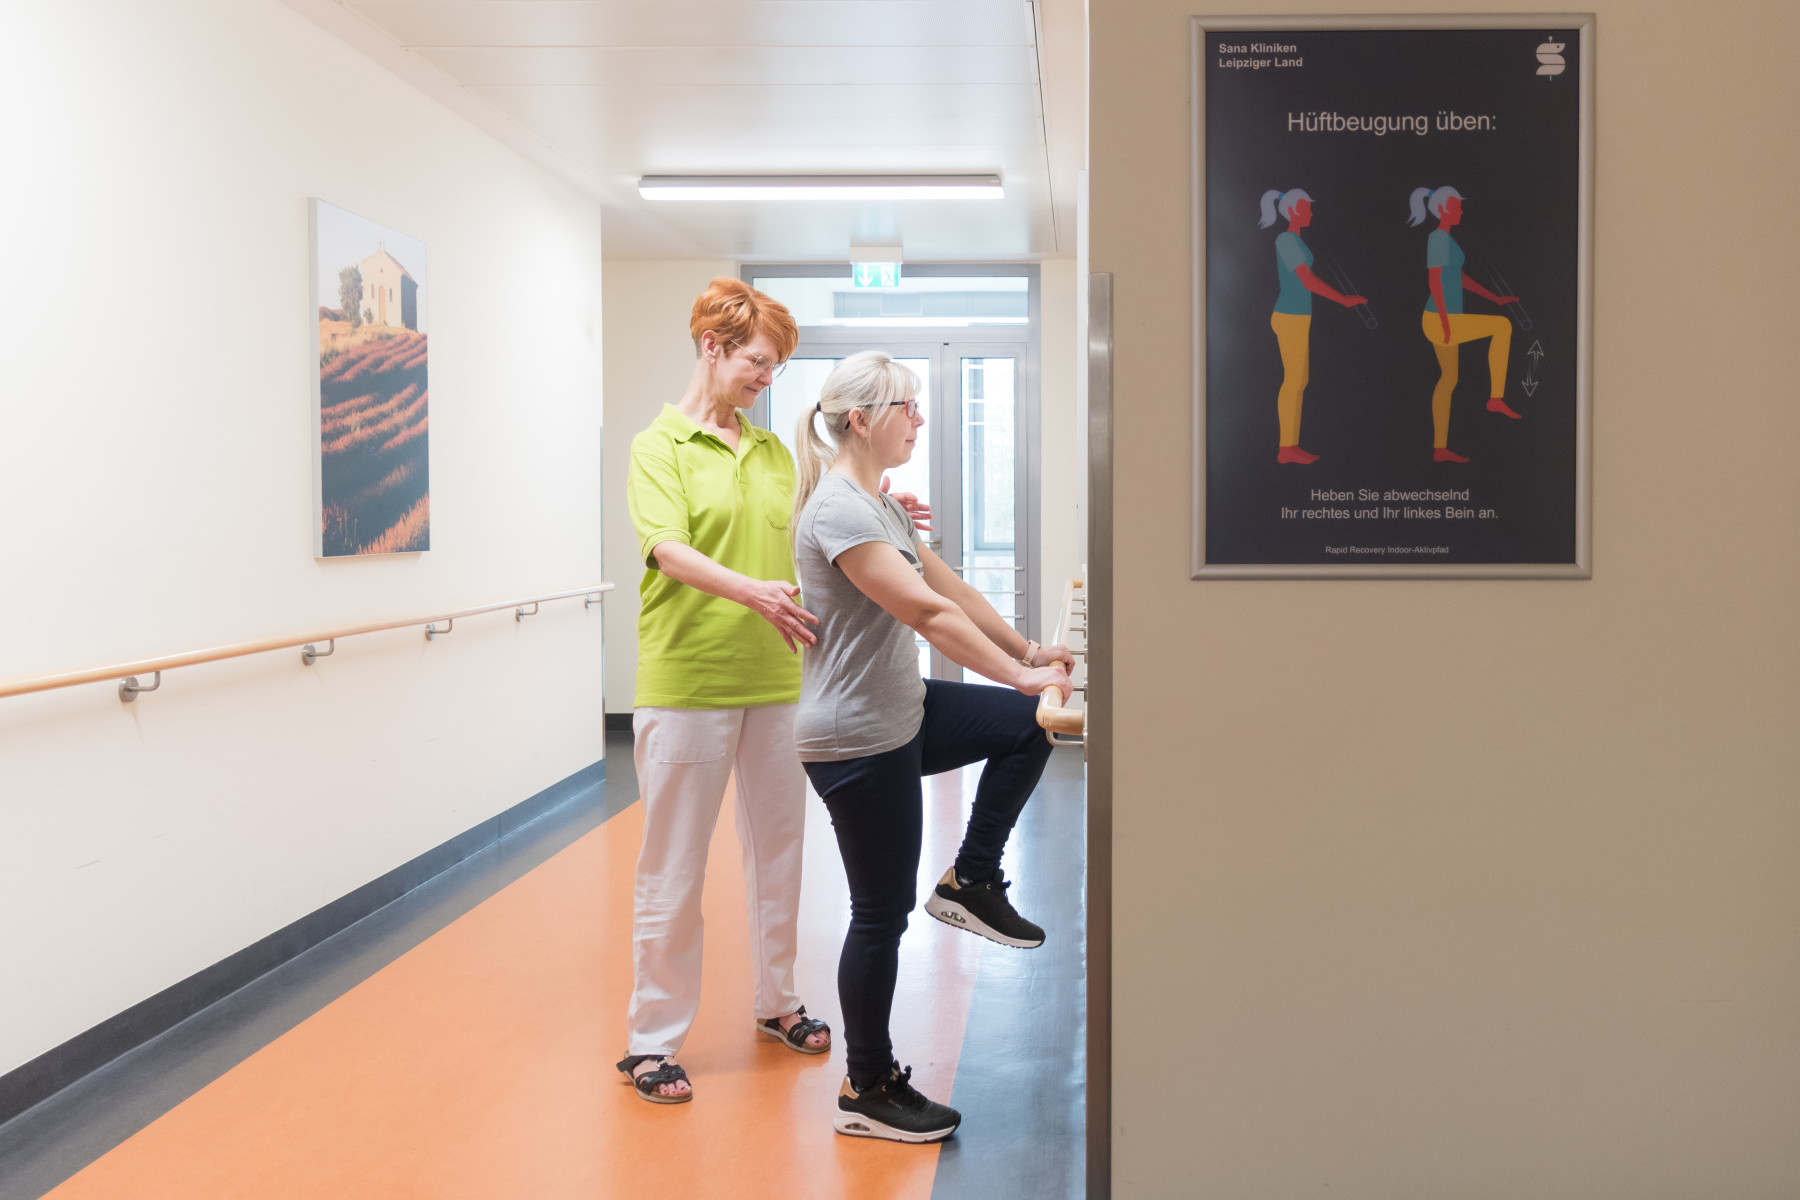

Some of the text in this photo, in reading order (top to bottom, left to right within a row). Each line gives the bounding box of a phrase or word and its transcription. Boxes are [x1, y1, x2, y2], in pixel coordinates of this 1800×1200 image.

[1219, 43, 1297, 54] Sana Kliniken
[1219, 57, 1303, 70] Leipziger Land
[1288, 110, 1497, 137] Hüftbeugung üben:
[1310, 488, 1470, 501] Heben Sie abwechselnd
[1281, 506, 1499, 519] Ihr rechtes und Ihr linkes Bein an.
[1325, 545, 1450, 555] Rapid Recovery Indoor-Aktivpfad
